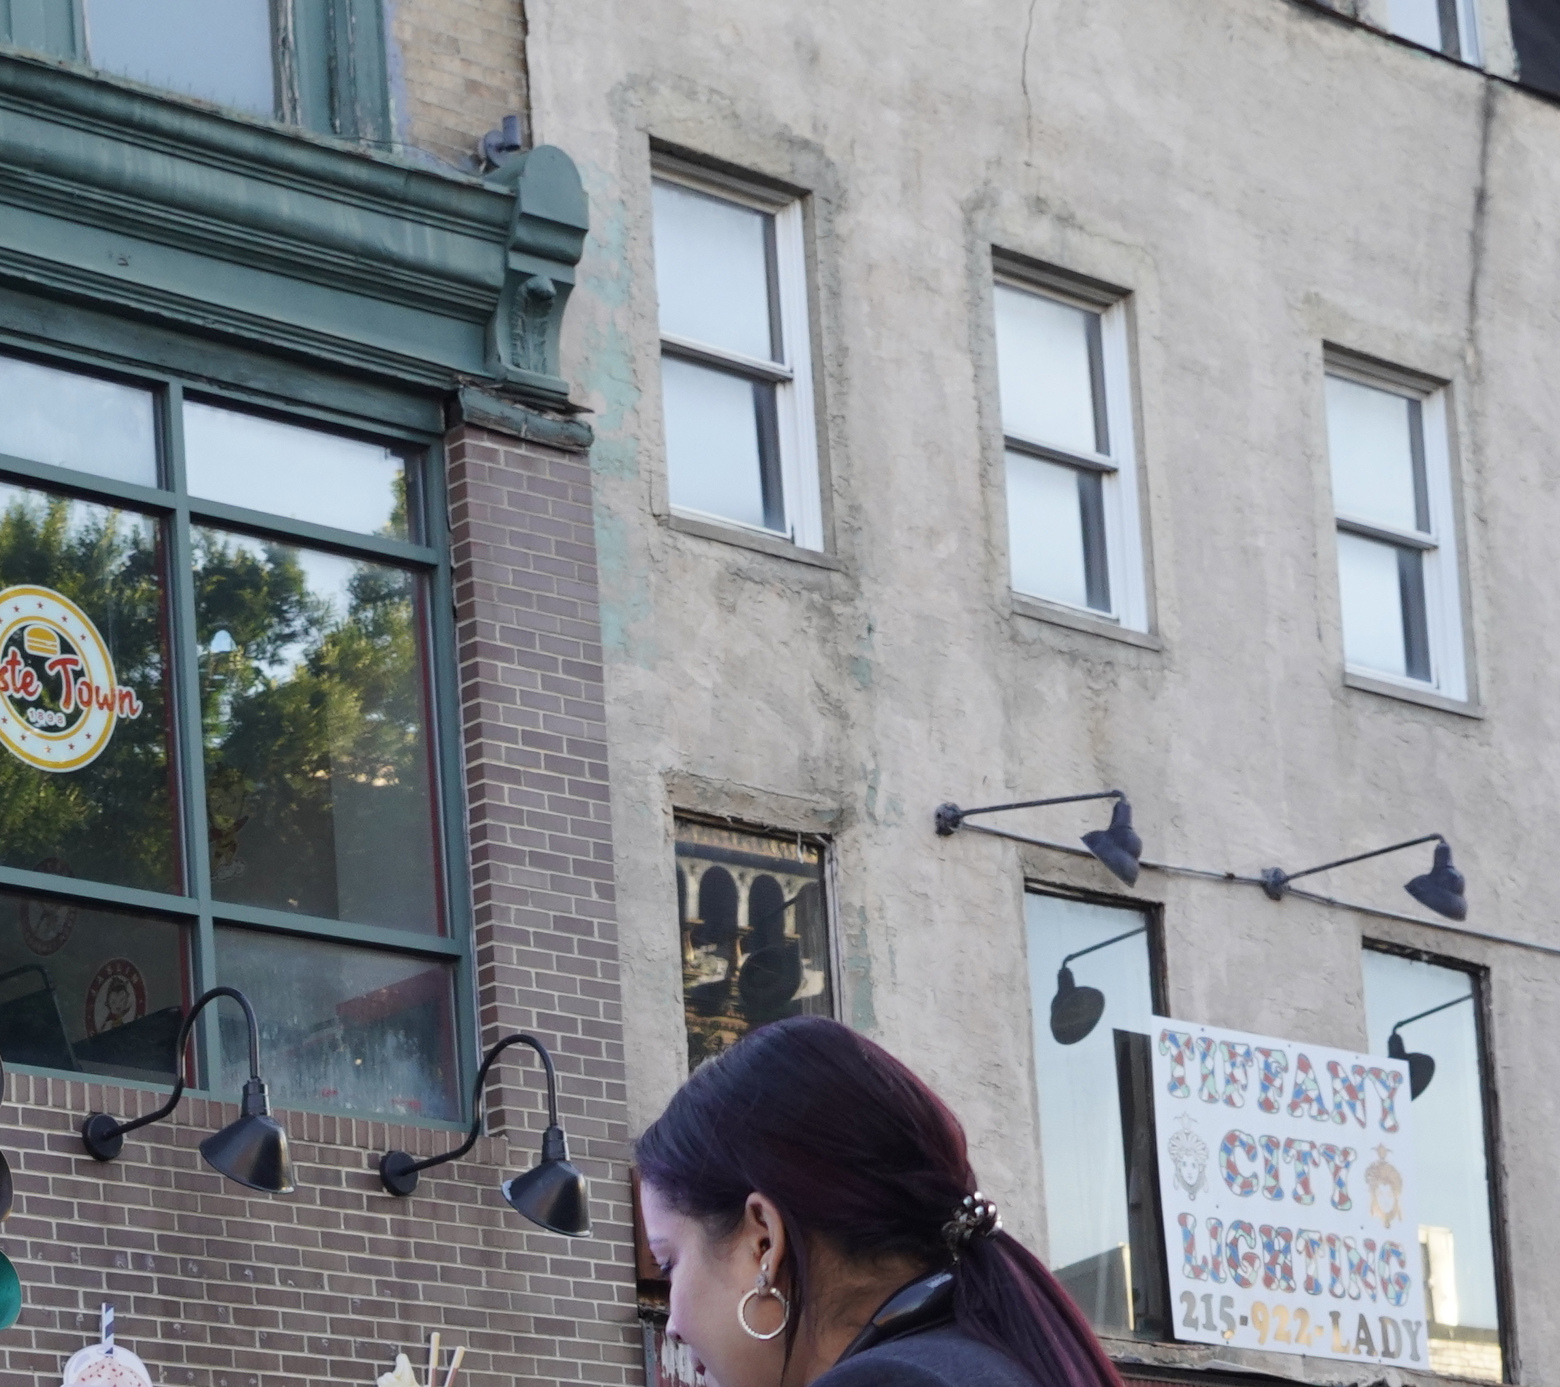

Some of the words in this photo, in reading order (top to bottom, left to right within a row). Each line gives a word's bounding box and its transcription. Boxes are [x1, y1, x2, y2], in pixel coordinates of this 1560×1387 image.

[29, 711, 64, 725] 1898
[48, 657, 140, 716] Town
[1158, 1028, 1404, 1133] TIFFANY
[1218, 1128, 1358, 1211] CITY
[1177, 1212, 1412, 1307] LIGHTING
[1180, 1290, 1423, 1362] 215-922-LADY
